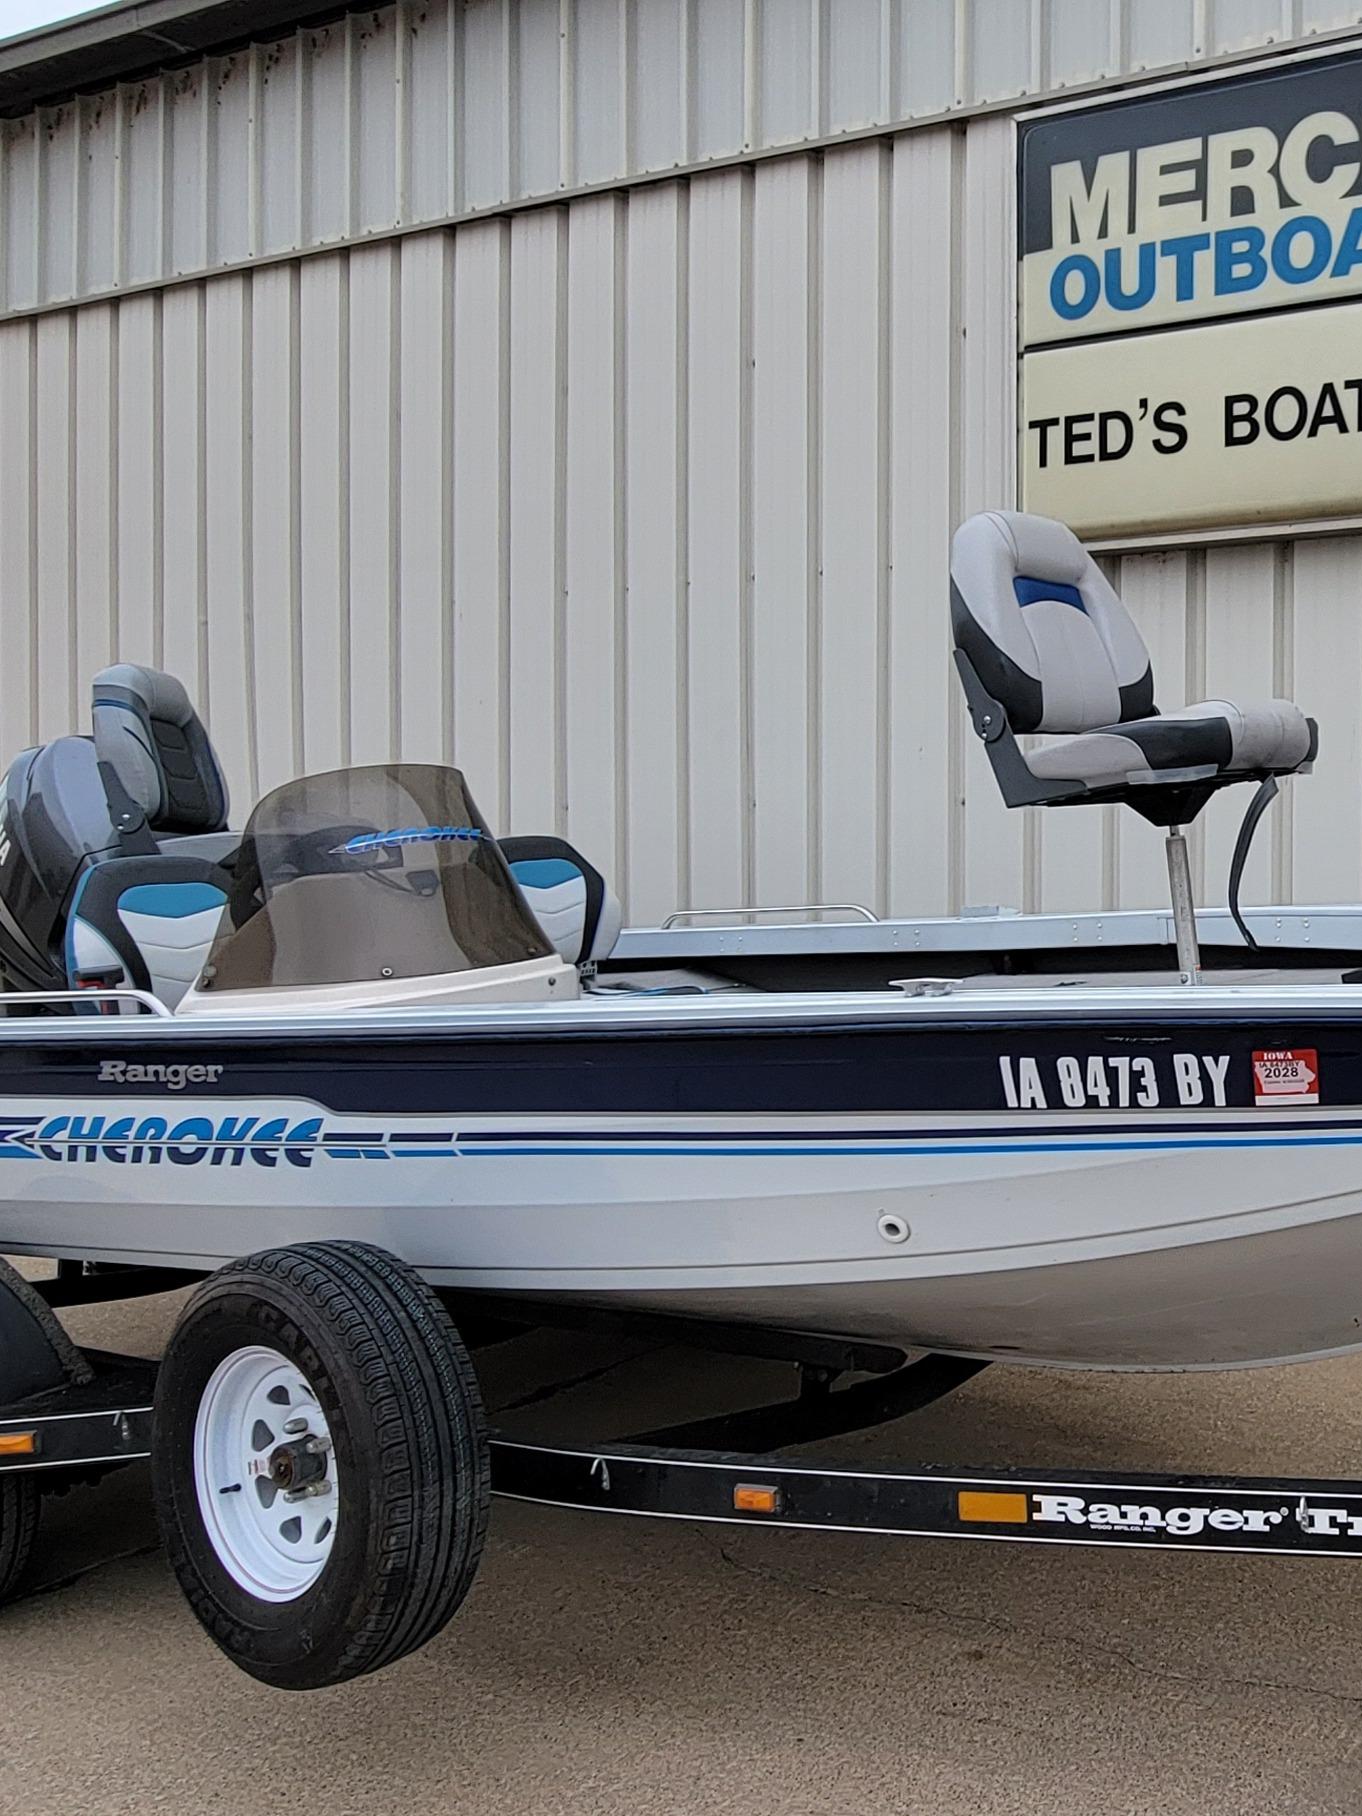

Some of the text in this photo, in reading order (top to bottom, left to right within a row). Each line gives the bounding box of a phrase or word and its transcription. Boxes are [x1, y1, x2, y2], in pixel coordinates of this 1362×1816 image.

[1028, 397, 1188, 469] TED'S
[97, 1060, 224, 1090] Ranger
[1263, 1051, 1293, 1061] IOWA
[1264, 1067, 1299, 1078] 2028
[999, 1053, 1231, 1109] IA 8473 BY
[36, 1116, 325, 1167] CHEROKEE
